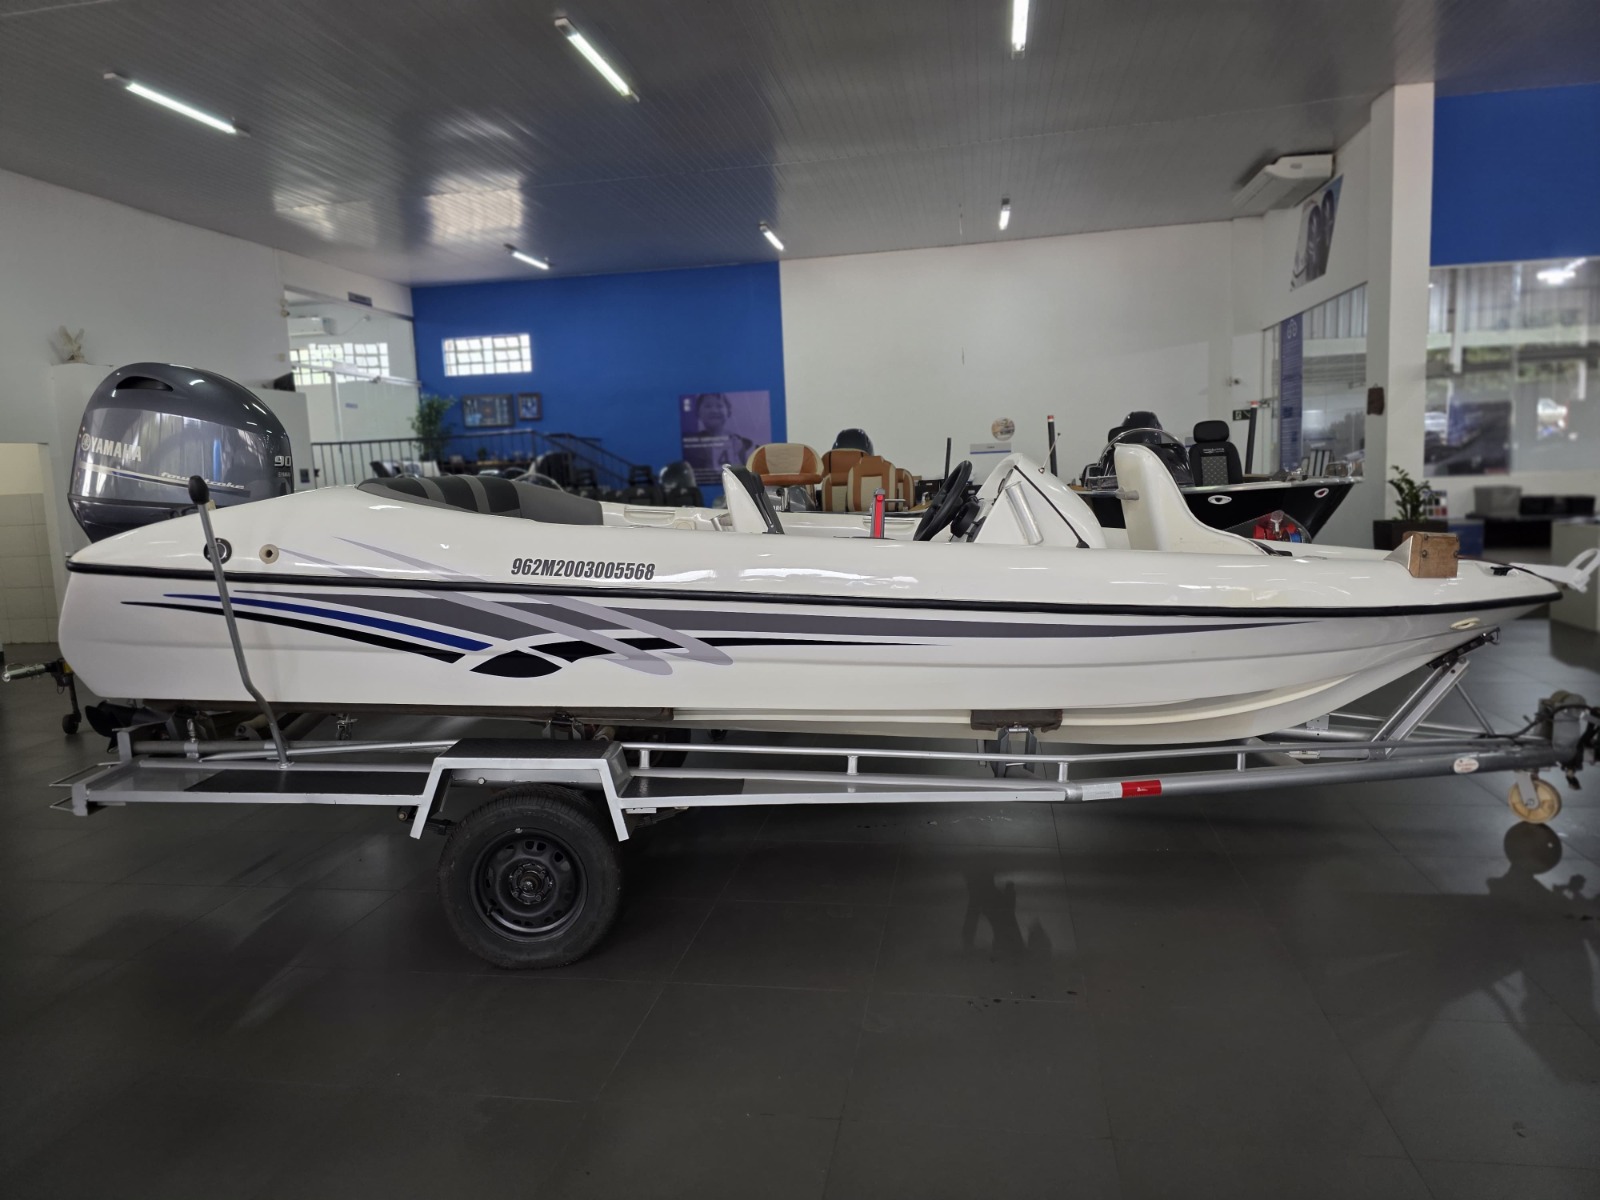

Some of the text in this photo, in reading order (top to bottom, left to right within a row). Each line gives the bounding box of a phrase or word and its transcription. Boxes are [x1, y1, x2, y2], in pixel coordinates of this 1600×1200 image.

[91, 436, 142, 462] YAMAHA
[274, 455, 291, 467] 90
[511, 558, 656, 581] 962M2003005568
